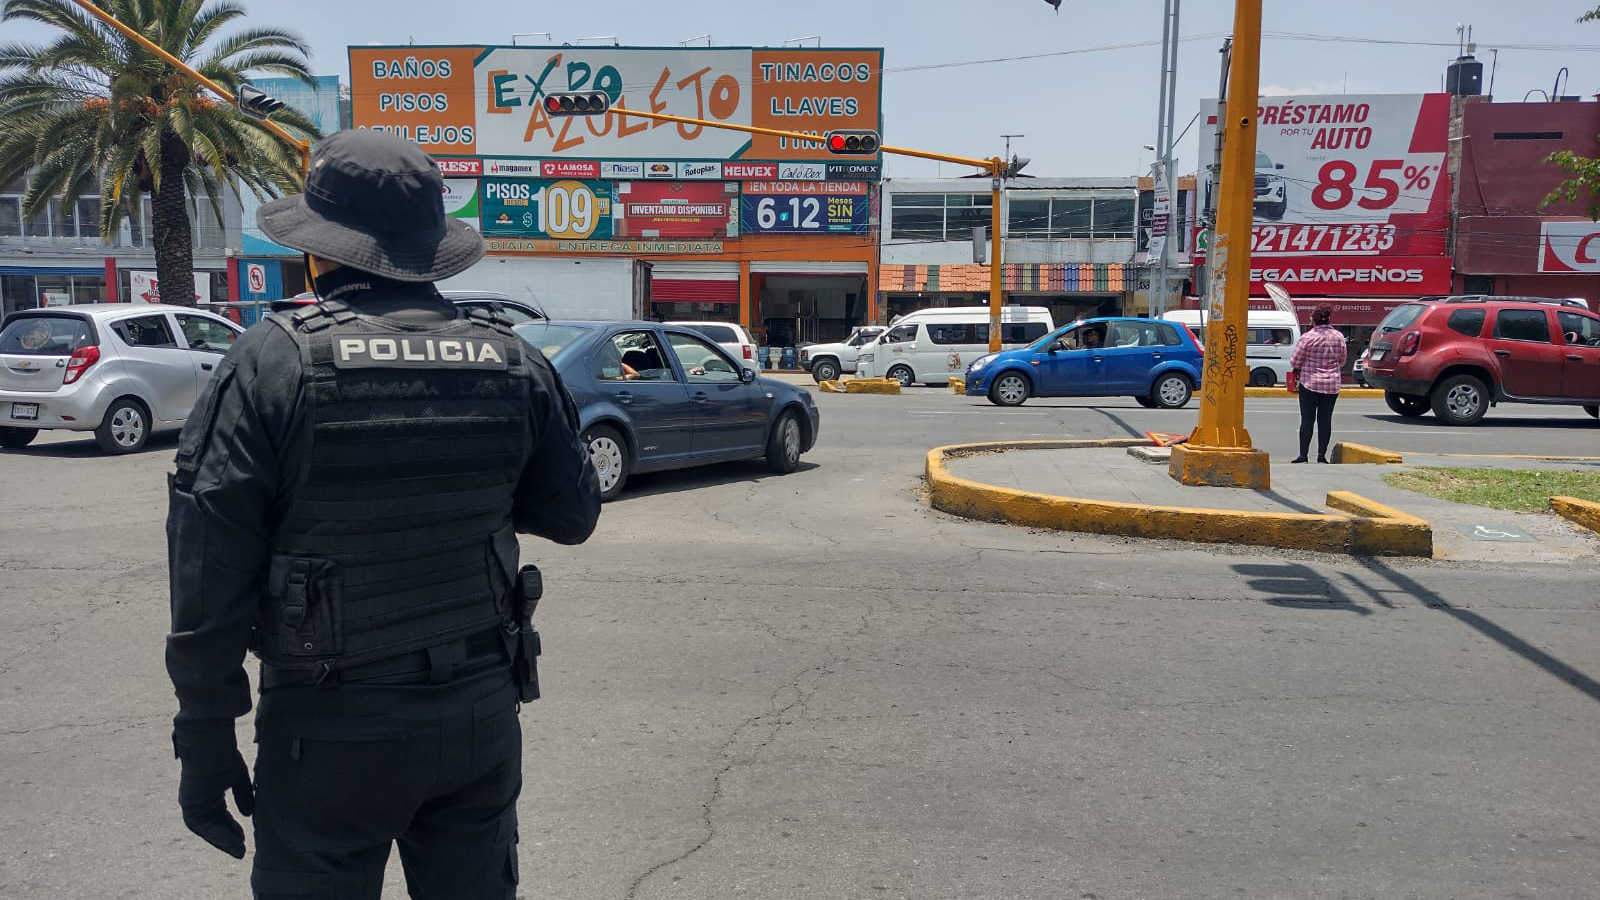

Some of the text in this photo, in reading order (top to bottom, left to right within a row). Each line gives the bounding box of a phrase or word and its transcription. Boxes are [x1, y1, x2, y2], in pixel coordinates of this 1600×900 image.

[373, 56, 452, 79] BAÑOS
[760, 63, 870, 82] TINACOS
[487, 54, 622, 113] EXPO
[380, 93, 447, 112] PISOS
[770, 97, 858, 116] LLAVES
[358, 125, 474, 145] LEJOS
[1280, 128, 1314, 137] POR TU
[1310, 126, 1373, 150] AUTO
[436, 161, 479, 172] REST
[685, 165, 715, 177] Rotoplas
[725, 166, 773, 177] HELVEX
[487, 183, 530, 200] PISOS
[770, 181, 799, 193] TODA
[802, 181, 816, 193] LA
[819, 181, 861, 193] TIENDA!
[531, 186, 592, 233] 109
[631, 205, 723, 215] INVENTARIO DISPONIBLE
[757, 197, 777, 229] 6
[788, 197, 820, 229] 12
[828, 204, 853, 217] SIN
[558, 242, 631, 252] ENTREGA
[636, 242, 722, 253] INMEDIATA
[1249, 265, 1424, 282] EGAEMPEÑOS
[339, 338, 503, 363] POLICIA
